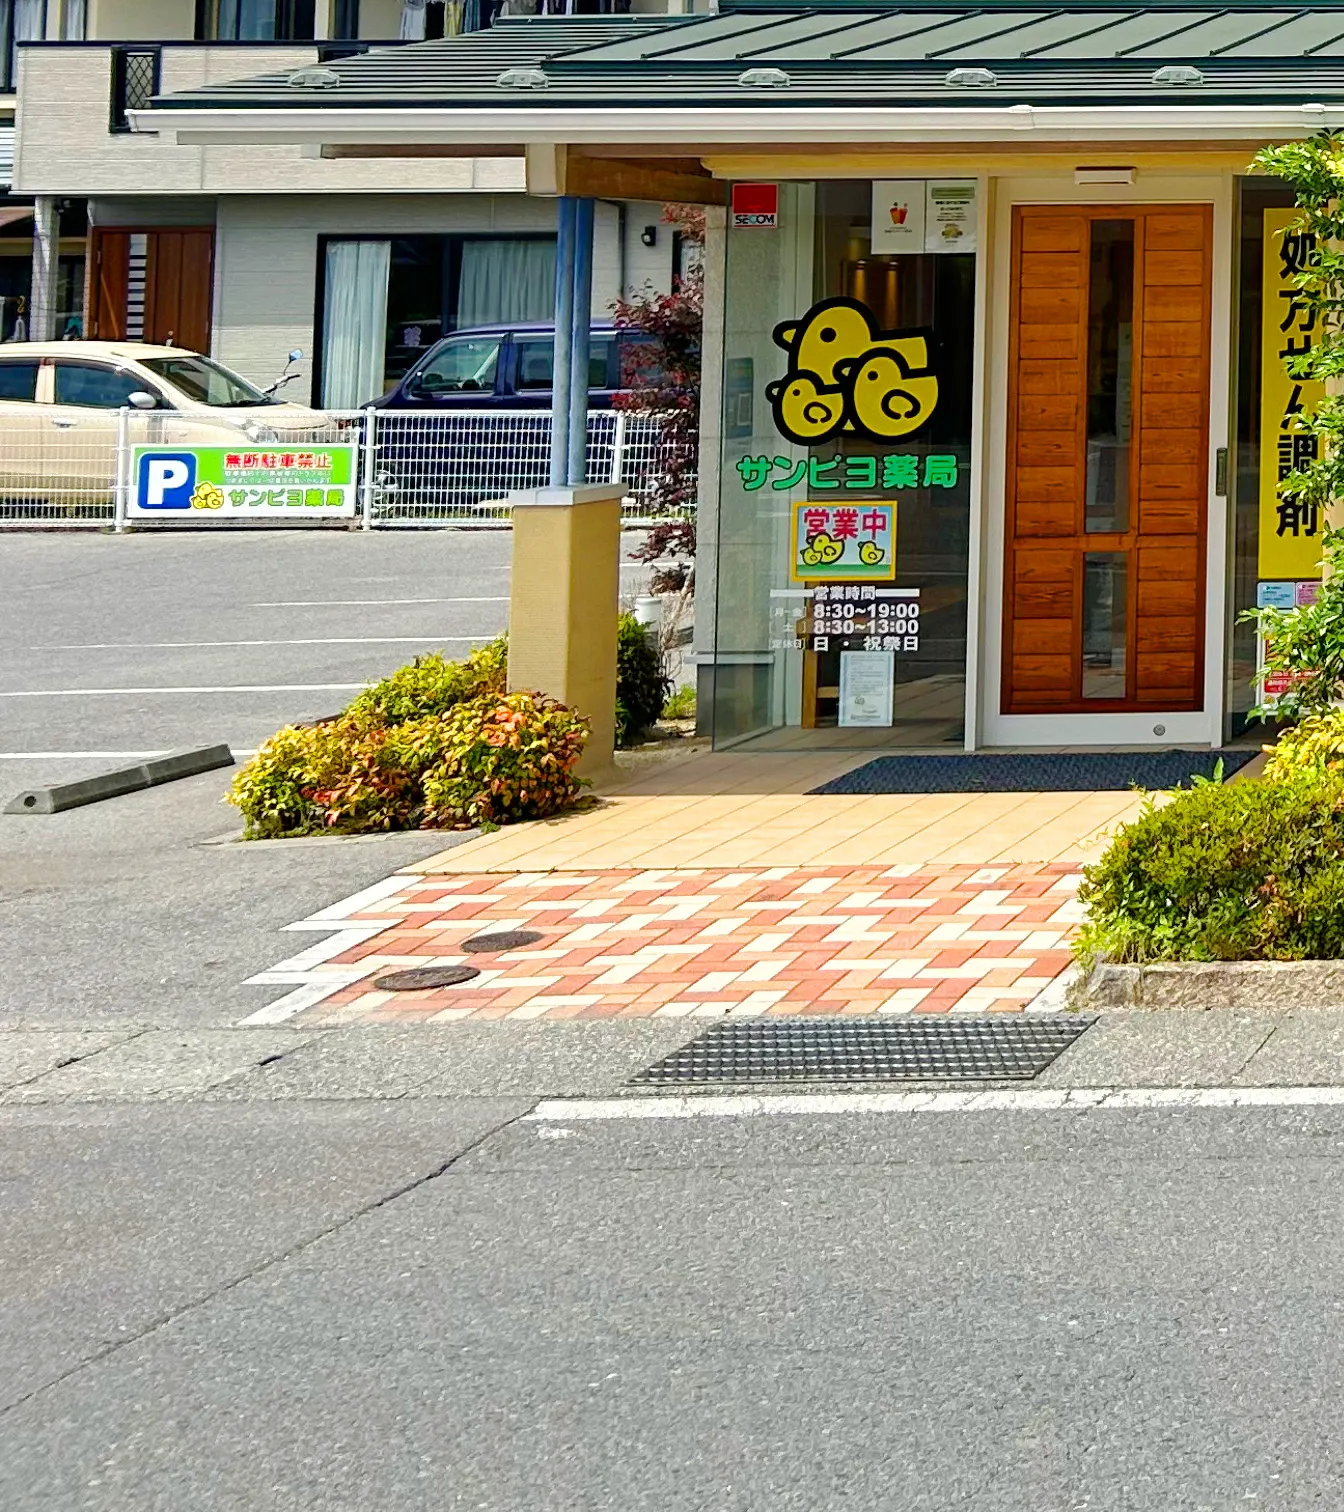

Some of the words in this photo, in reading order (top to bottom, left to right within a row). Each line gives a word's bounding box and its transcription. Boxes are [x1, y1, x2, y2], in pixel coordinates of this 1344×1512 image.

[735, 214, 775, 225] SECOM
[225, 452, 332, 469] 無断駐車禁止
[735, 452, 959, 492] サンピヨ薬局
[146, 459, 189, 505] P
[228, 488, 345, 507] サンピヨ薬局
[803, 507, 888, 541] 営業中
[813, 585, 876, 601] 営業時間
